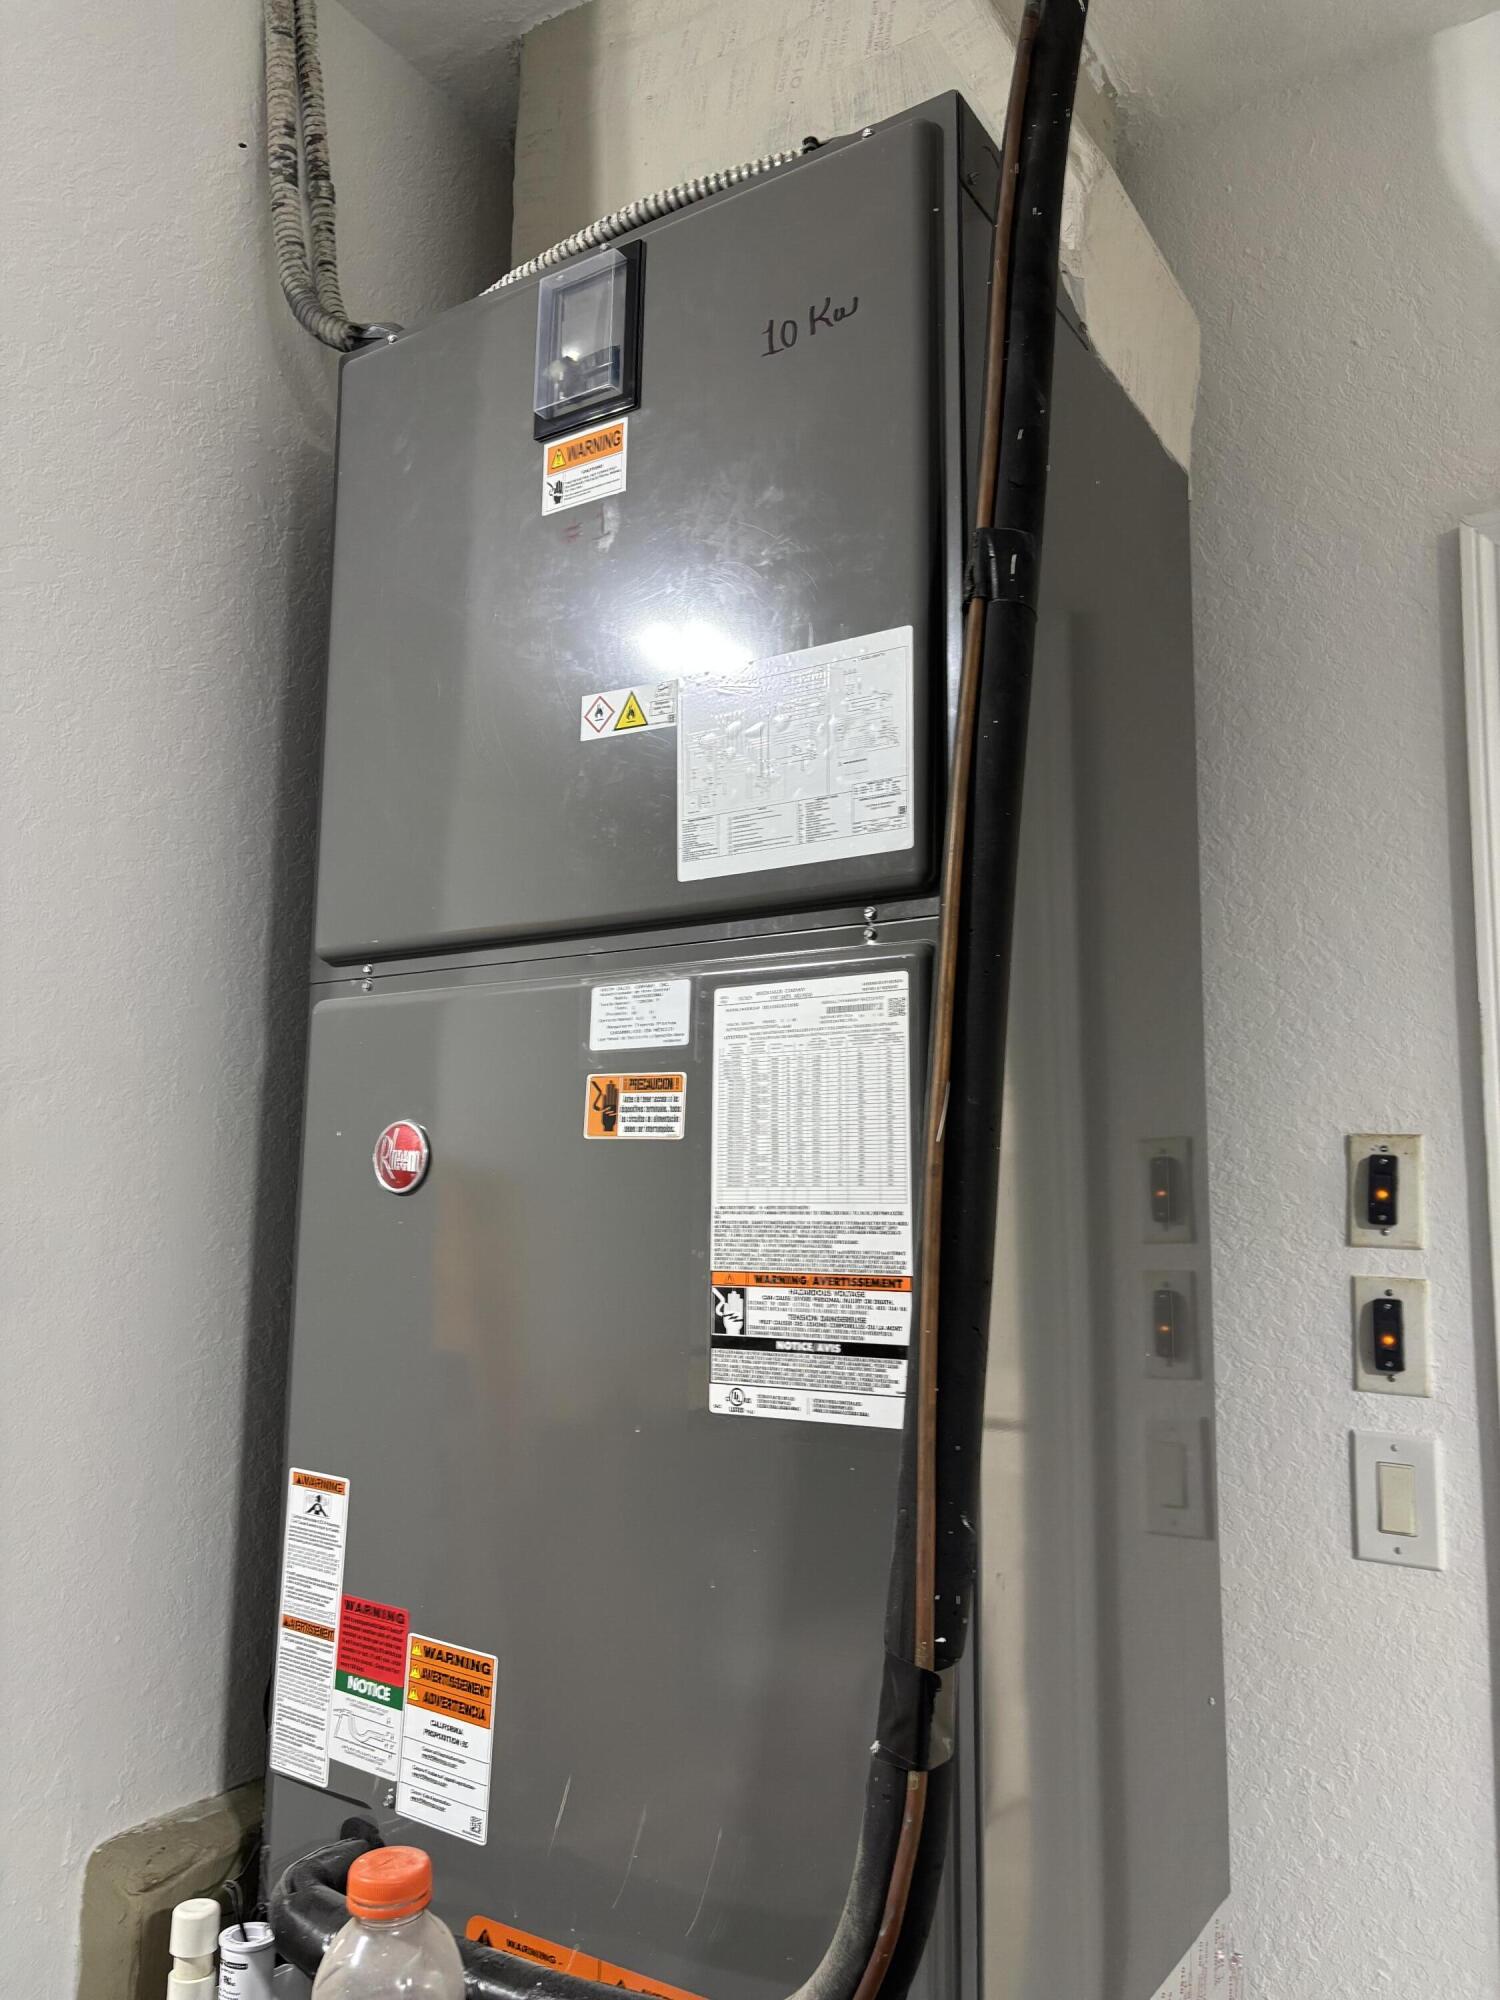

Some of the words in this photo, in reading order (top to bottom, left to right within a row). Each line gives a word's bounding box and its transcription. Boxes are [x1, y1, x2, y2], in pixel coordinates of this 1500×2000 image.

[761, 319, 798, 357] 10
[567, 430, 621, 462] WARNING
[343, 1599, 405, 1625] WARNING
[423, 1645, 491, 1676] WARNING
[347, 1675, 391, 1701] NOTICE
[505, 1938, 557, 1965] WARNING
